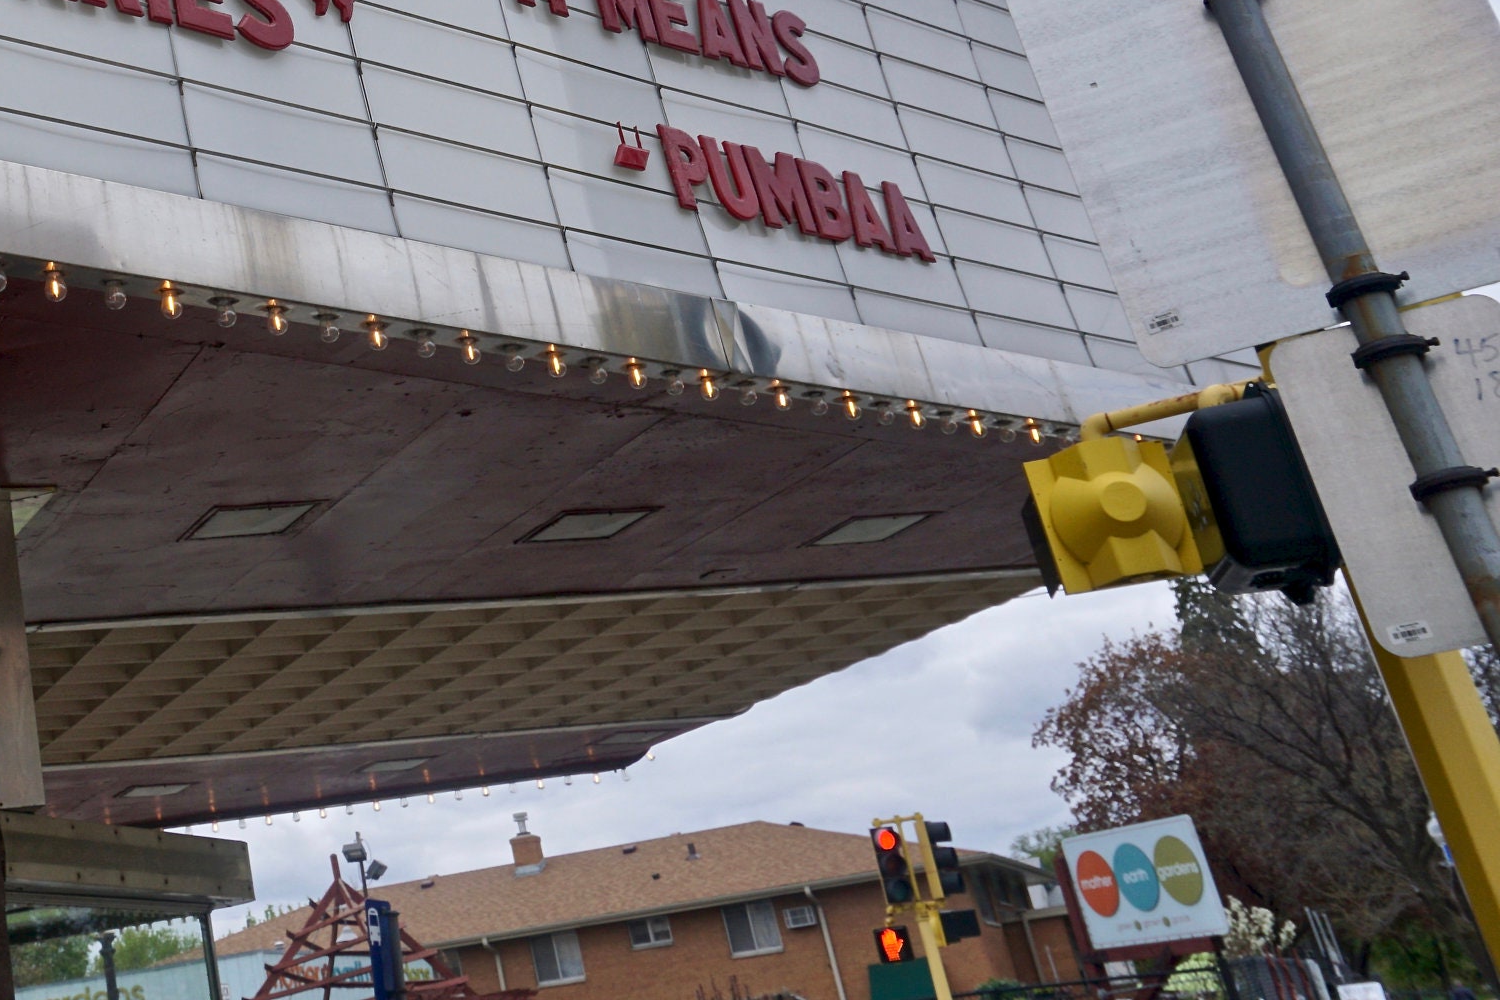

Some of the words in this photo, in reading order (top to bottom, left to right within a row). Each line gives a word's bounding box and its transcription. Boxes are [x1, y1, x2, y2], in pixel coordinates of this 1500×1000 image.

[1080, 875, 1113, 890] mother
[1122, 868, 1148, 884] earth
[1156, 862, 1198, 882] gardens
